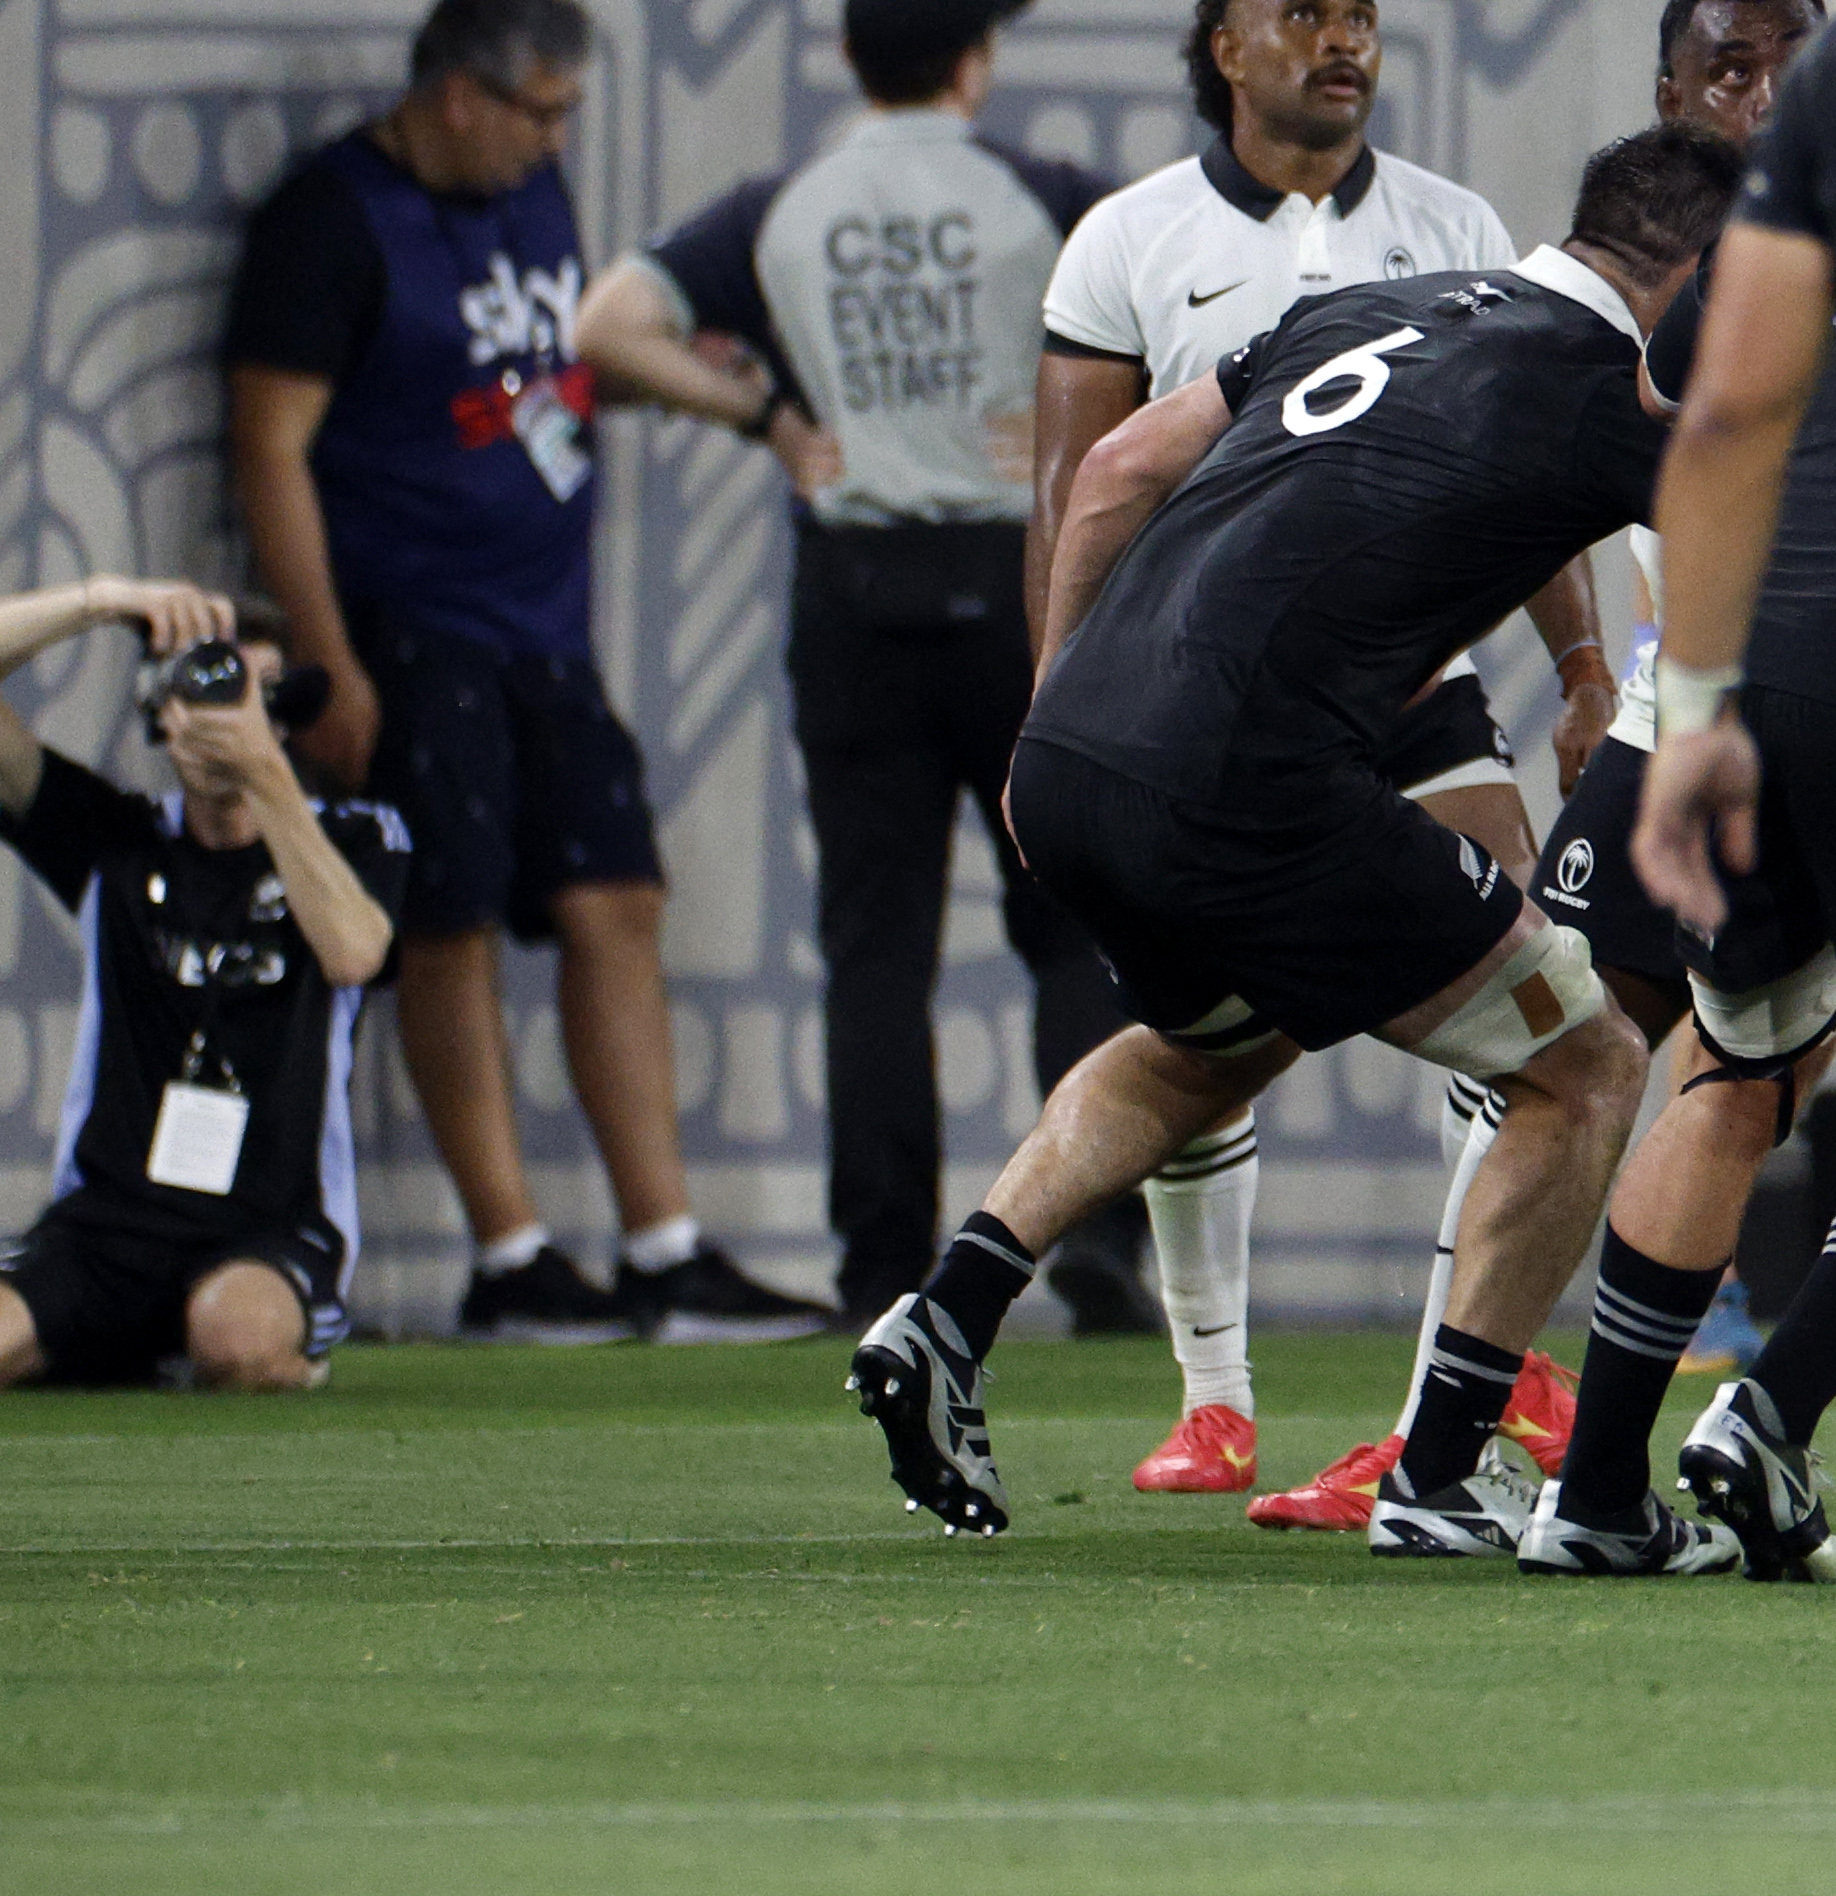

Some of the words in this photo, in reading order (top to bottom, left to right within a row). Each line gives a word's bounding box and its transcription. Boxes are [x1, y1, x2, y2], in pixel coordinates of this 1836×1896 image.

[826, 212, 977, 276] CSC
[830, 278, 976, 348] EVENT
[842, 350, 983, 413] STAFF
[1282, 326, 1425, 437] 6
[1558, 892, 1591, 911] RUGBY
